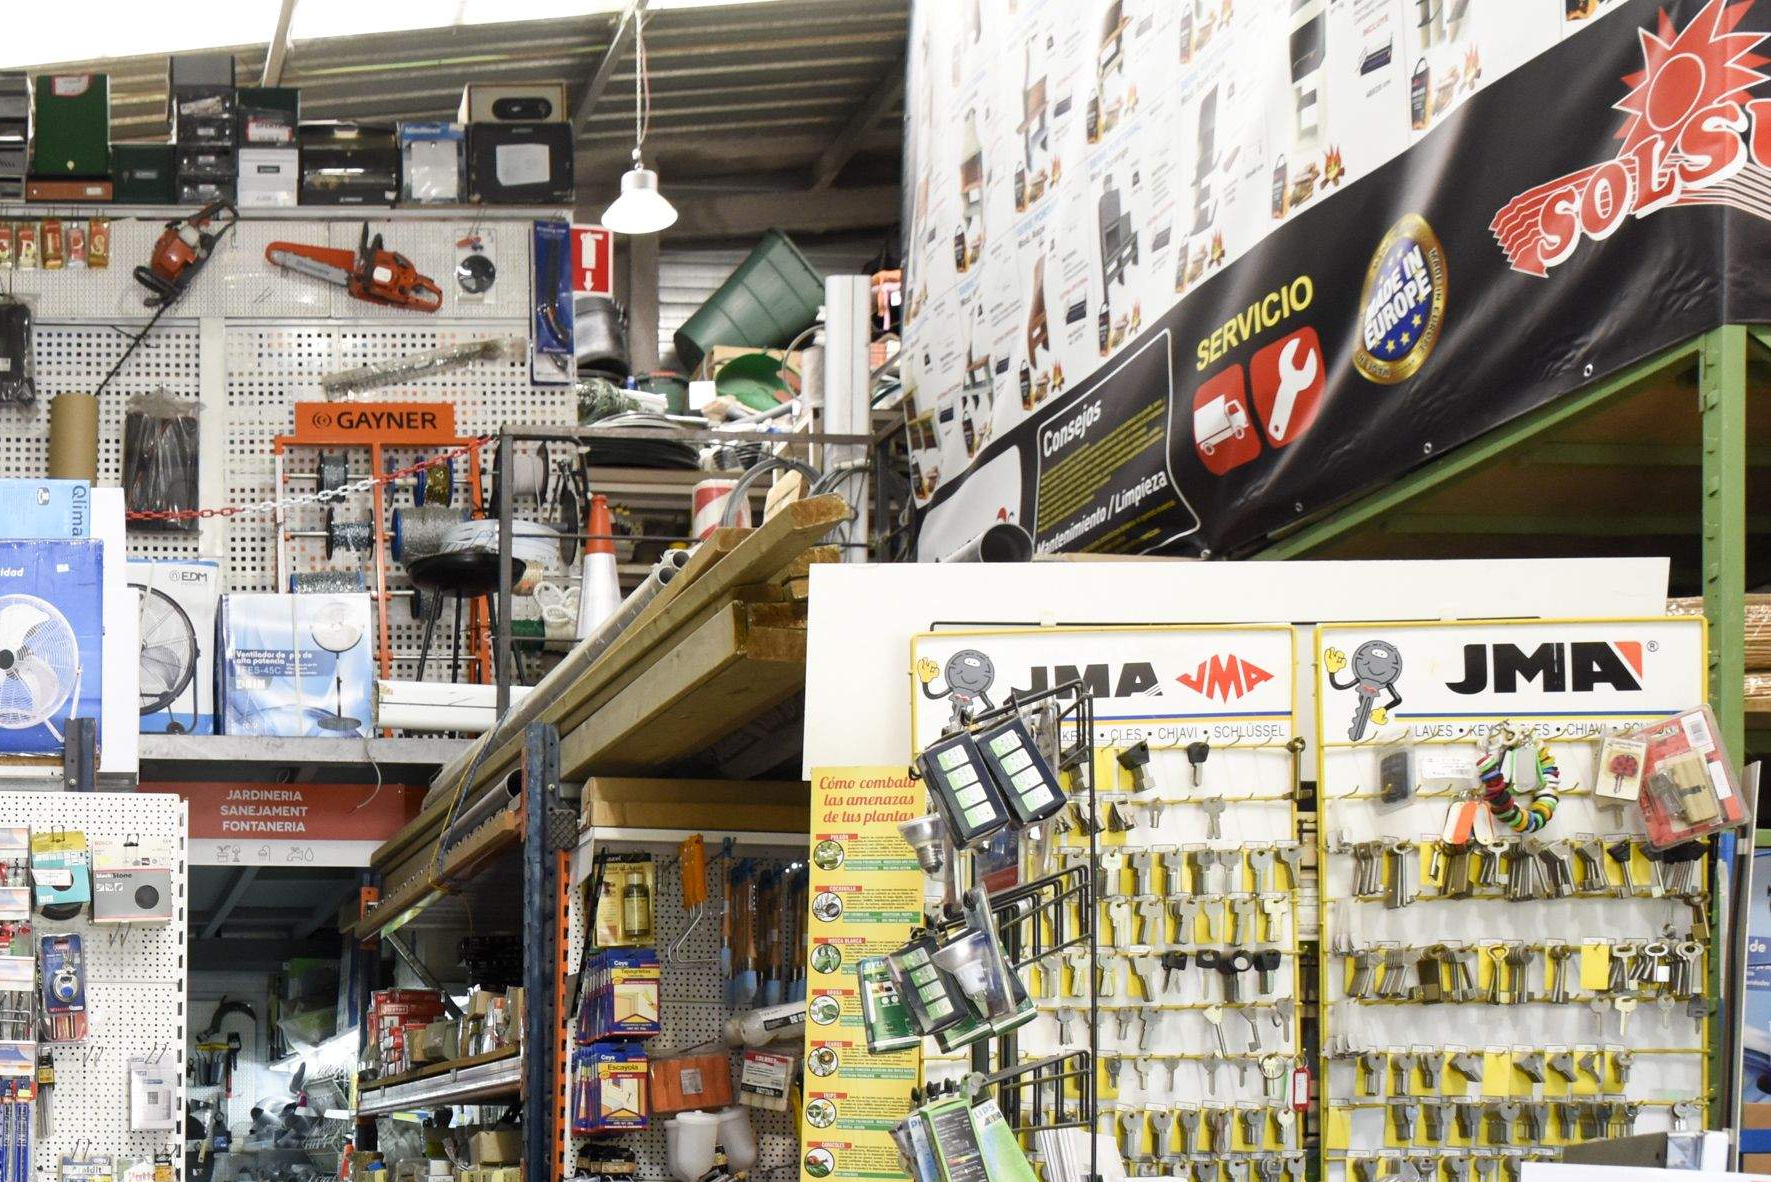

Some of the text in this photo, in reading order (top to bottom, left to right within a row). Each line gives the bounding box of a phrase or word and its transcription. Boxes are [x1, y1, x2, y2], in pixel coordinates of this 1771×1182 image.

[1402, 245, 1425, 278] IN
[1363, 267, 1433, 351] EUROPE
[1195, 275, 1314, 371] SERVICIO
[336, 411, 438, 430] GAYNER
[1043, 399, 1103, 458] Consejos
[70, 484, 88, 537] Qlima
[1036, 505, 1107, 554] Mantenimiento
[1114, 470, 1169, 514] Limpieza
[181, 572, 209, 582] EDM
[1444, 641, 1644, 696] JMA
[1003, 653, 1276, 705] JMA JMA
[1158, 727, 1199, 740] CHIAVI
[1213, 722, 1286, 740] SCHLÜSSEL
[1410, 724, 1454, 738] LAVES
[819, 775, 856, 791] Cómo
[225, 789, 304, 802] JARDINERIA
[824, 793, 915, 807] las amenazas
[219, 805, 309, 818] SANEJAMENT
[823, 809, 915, 826] de tus plantas
[221, 821, 306, 833] FONTANERIA
[607, 1064, 639, 1073] Escayola
